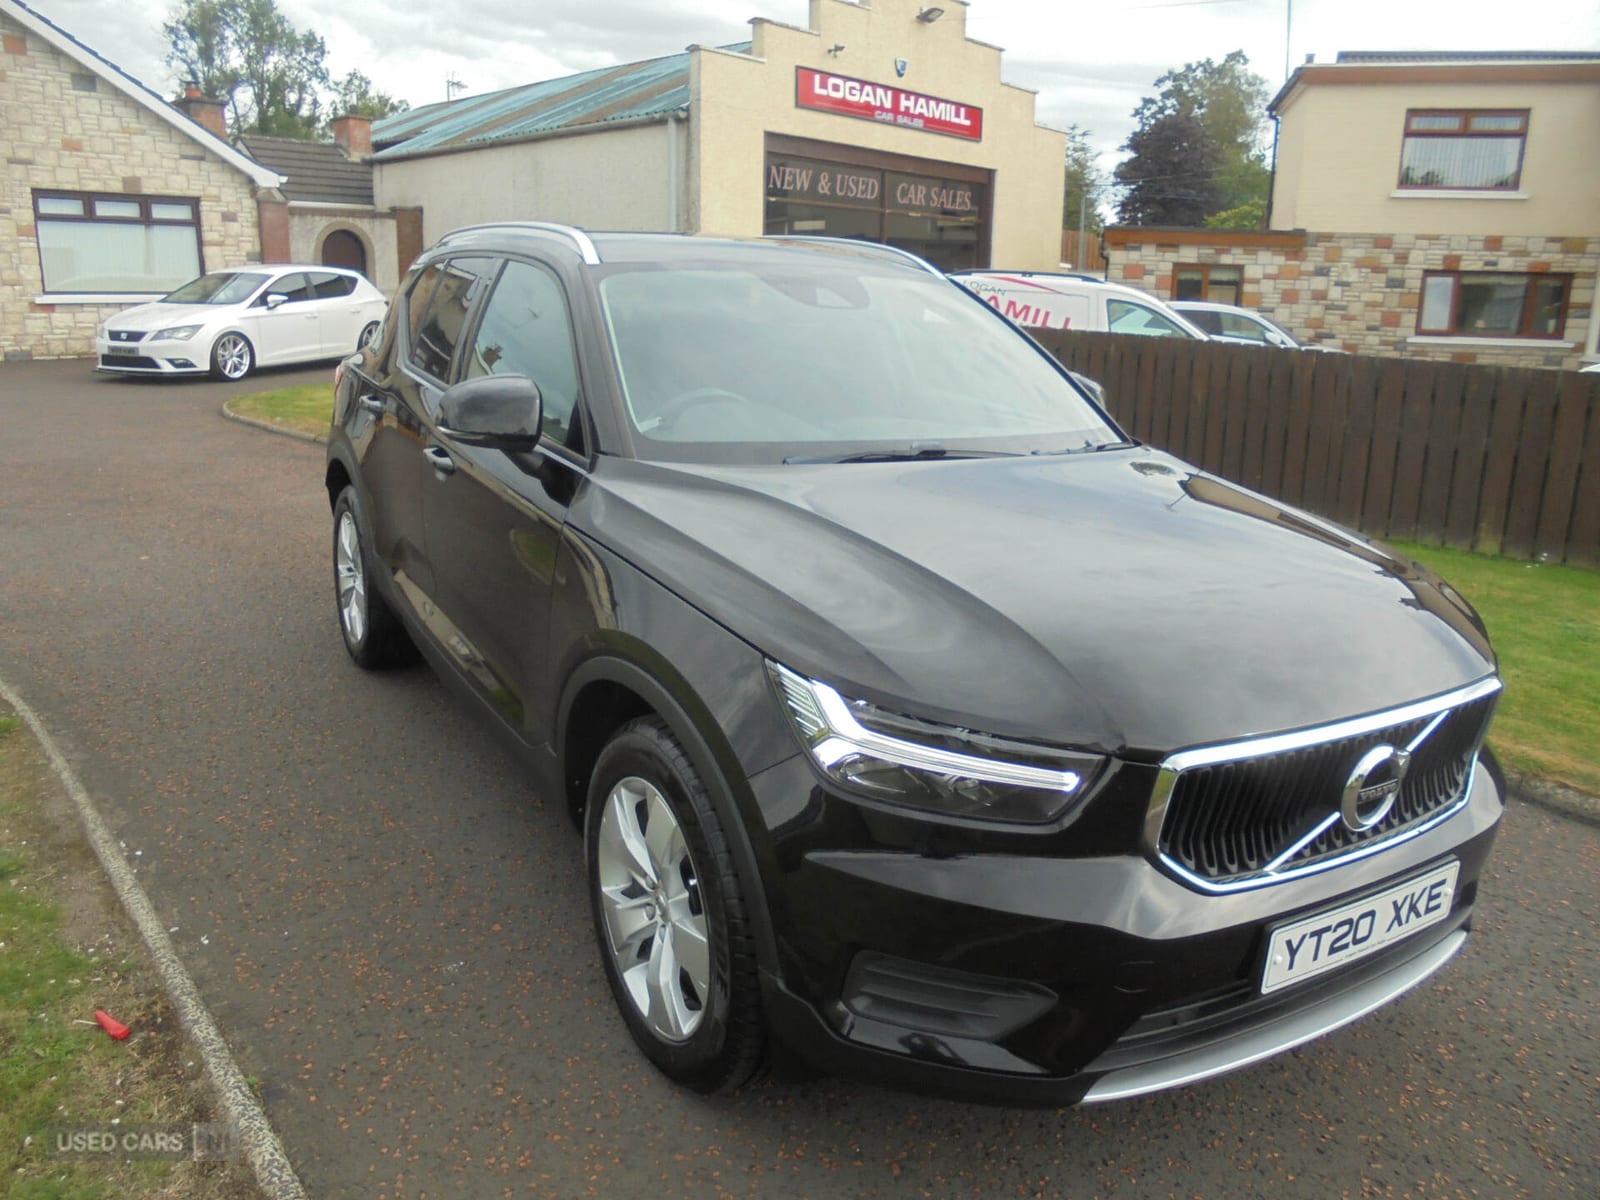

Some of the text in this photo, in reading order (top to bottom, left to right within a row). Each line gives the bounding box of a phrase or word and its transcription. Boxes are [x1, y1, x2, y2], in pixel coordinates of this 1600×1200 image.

[814, 74, 972, 126] LOGAN HAMILL
[875, 110, 924, 128] CAR SALES
[768, 165, 880, 200] NEW & USED
[896, 182, 972, 211] CAR SALES
[976, 290, 1071, 329] AMIL
[1285, 878, 1448, 972] YT20 XKE
